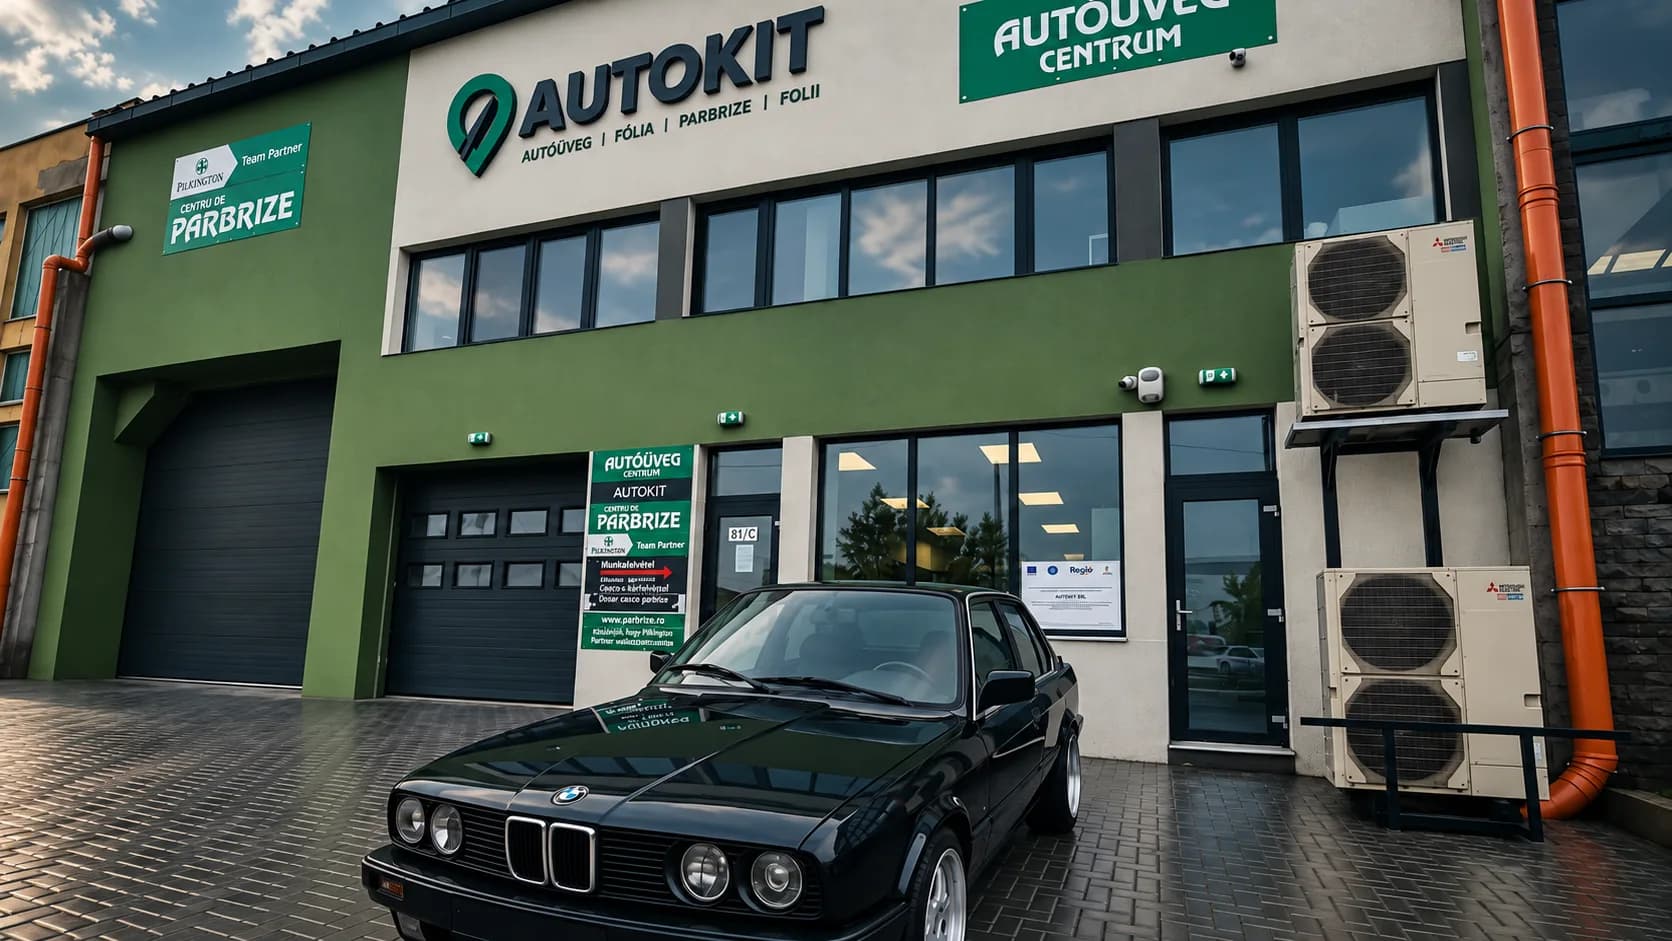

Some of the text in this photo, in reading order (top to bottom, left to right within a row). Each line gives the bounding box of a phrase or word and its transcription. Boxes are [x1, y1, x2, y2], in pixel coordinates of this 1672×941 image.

[1039, 24, 1182, 73] CENTRUM
[518, 5, 825, 139] AUTOKIT
[521, 83, 821, 164] AUTÓÜVEG FÓLIA PARBRIZE FOLII
[242, 143, 303, 166] Team Partner
[176, 172, 224, 193] PILKINGTON
[180, 194, 226, 214] CENTRU DE
[170, 191, 295, 244] PARBRIZE
[604, 451, 681, 472] AUTÓÜVEG
[623, 468, 661, 478] CENTRUM
[613, 485, 667, 499] AUTOKIT
[597, 512, 681, 531] PARBRIZE
[731, 528, 756, 541] 81/C
[636, 541, 686, 550] Team Partner
